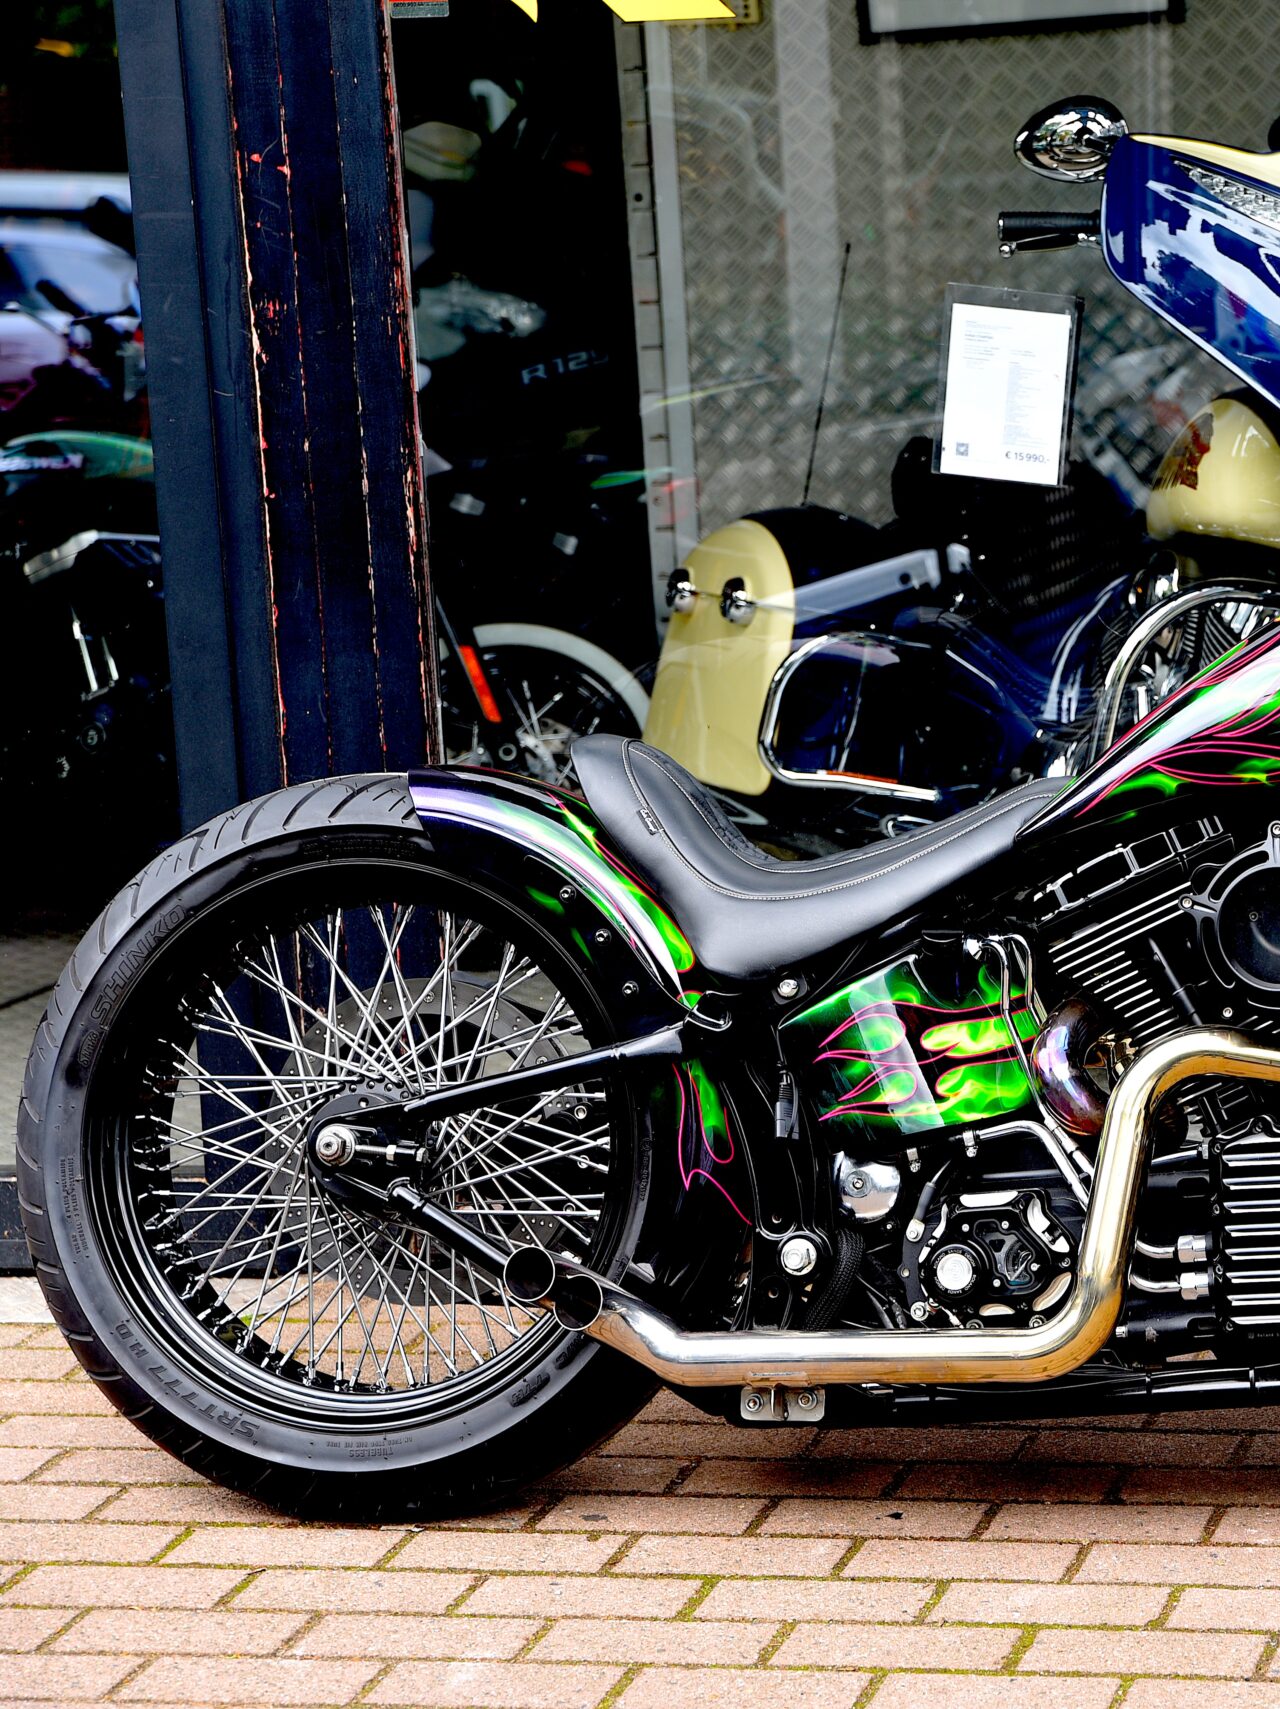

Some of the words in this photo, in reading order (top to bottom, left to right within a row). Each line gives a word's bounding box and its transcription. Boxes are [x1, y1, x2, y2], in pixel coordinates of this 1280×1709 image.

[521, 363, 547, 385] R
[90, 904, 186, 1022] SHINKO
[115, 1321, 149, 1359] H.D.
[148, 1365, 260, 1439] SRT777
[349, 1447, 394, 1457] TUBELESS
